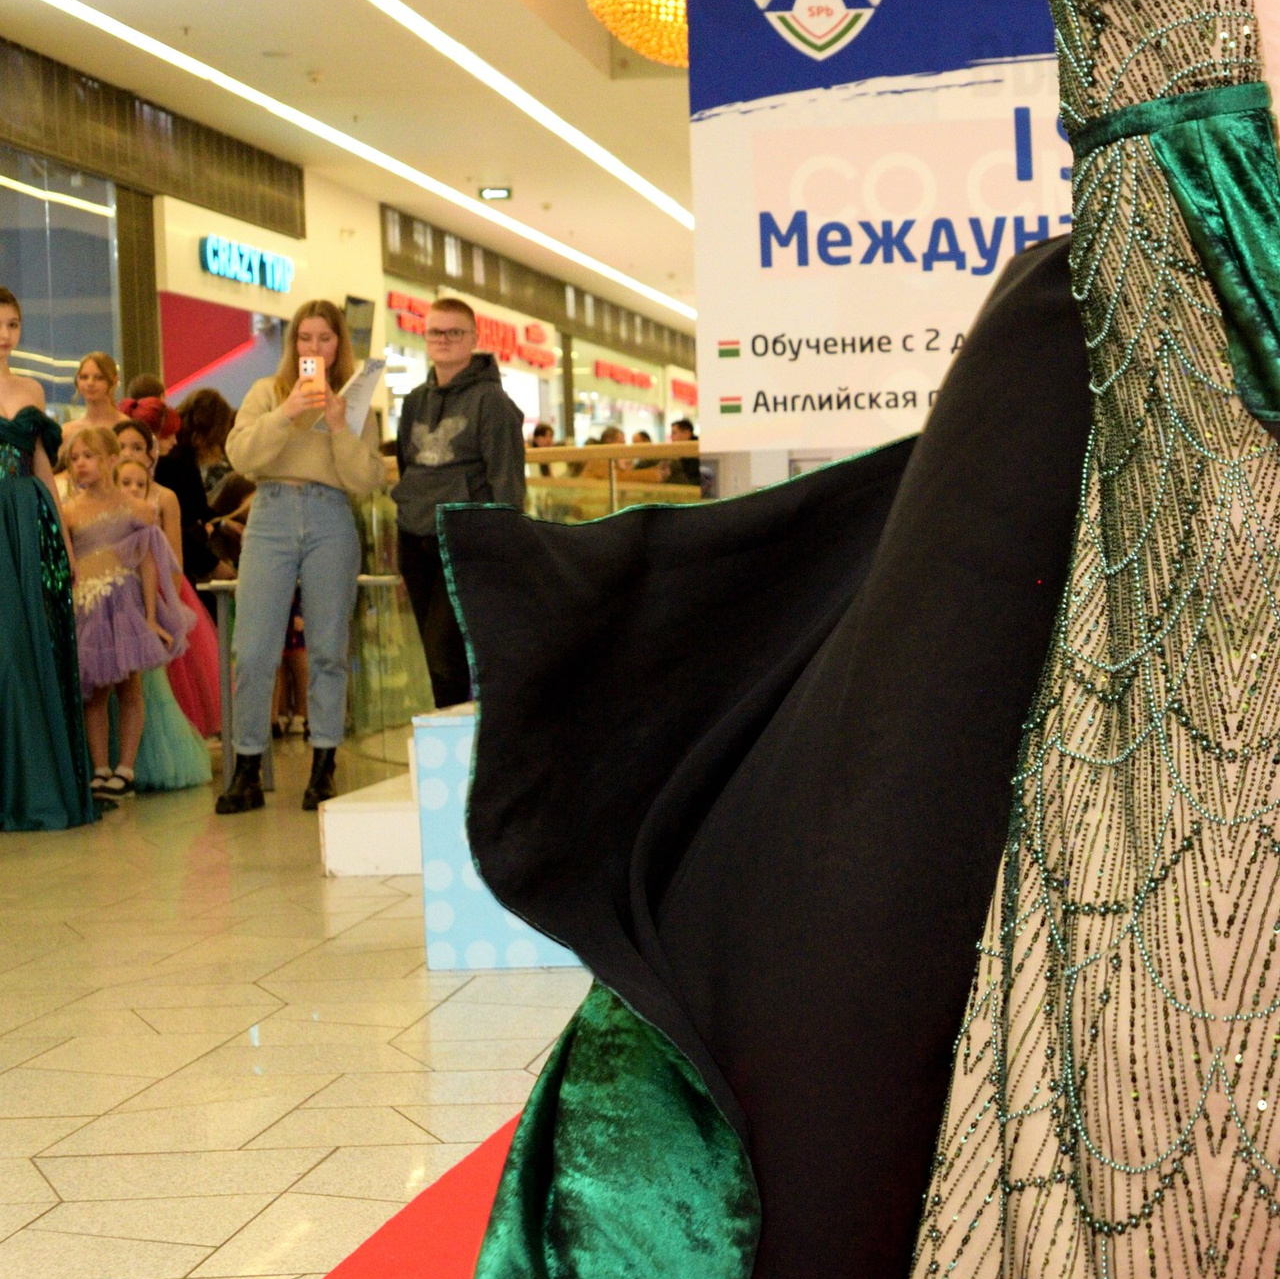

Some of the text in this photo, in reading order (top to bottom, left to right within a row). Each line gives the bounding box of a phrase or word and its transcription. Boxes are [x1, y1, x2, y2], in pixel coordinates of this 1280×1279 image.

[202, 233, 261, 285] CRAZY
[758, 210, 1072, 276] Междун
[750, 333, 892, 361] Обучение
[925, 328, 940, 351] 2
[752, 387, 917, 414] Английская
